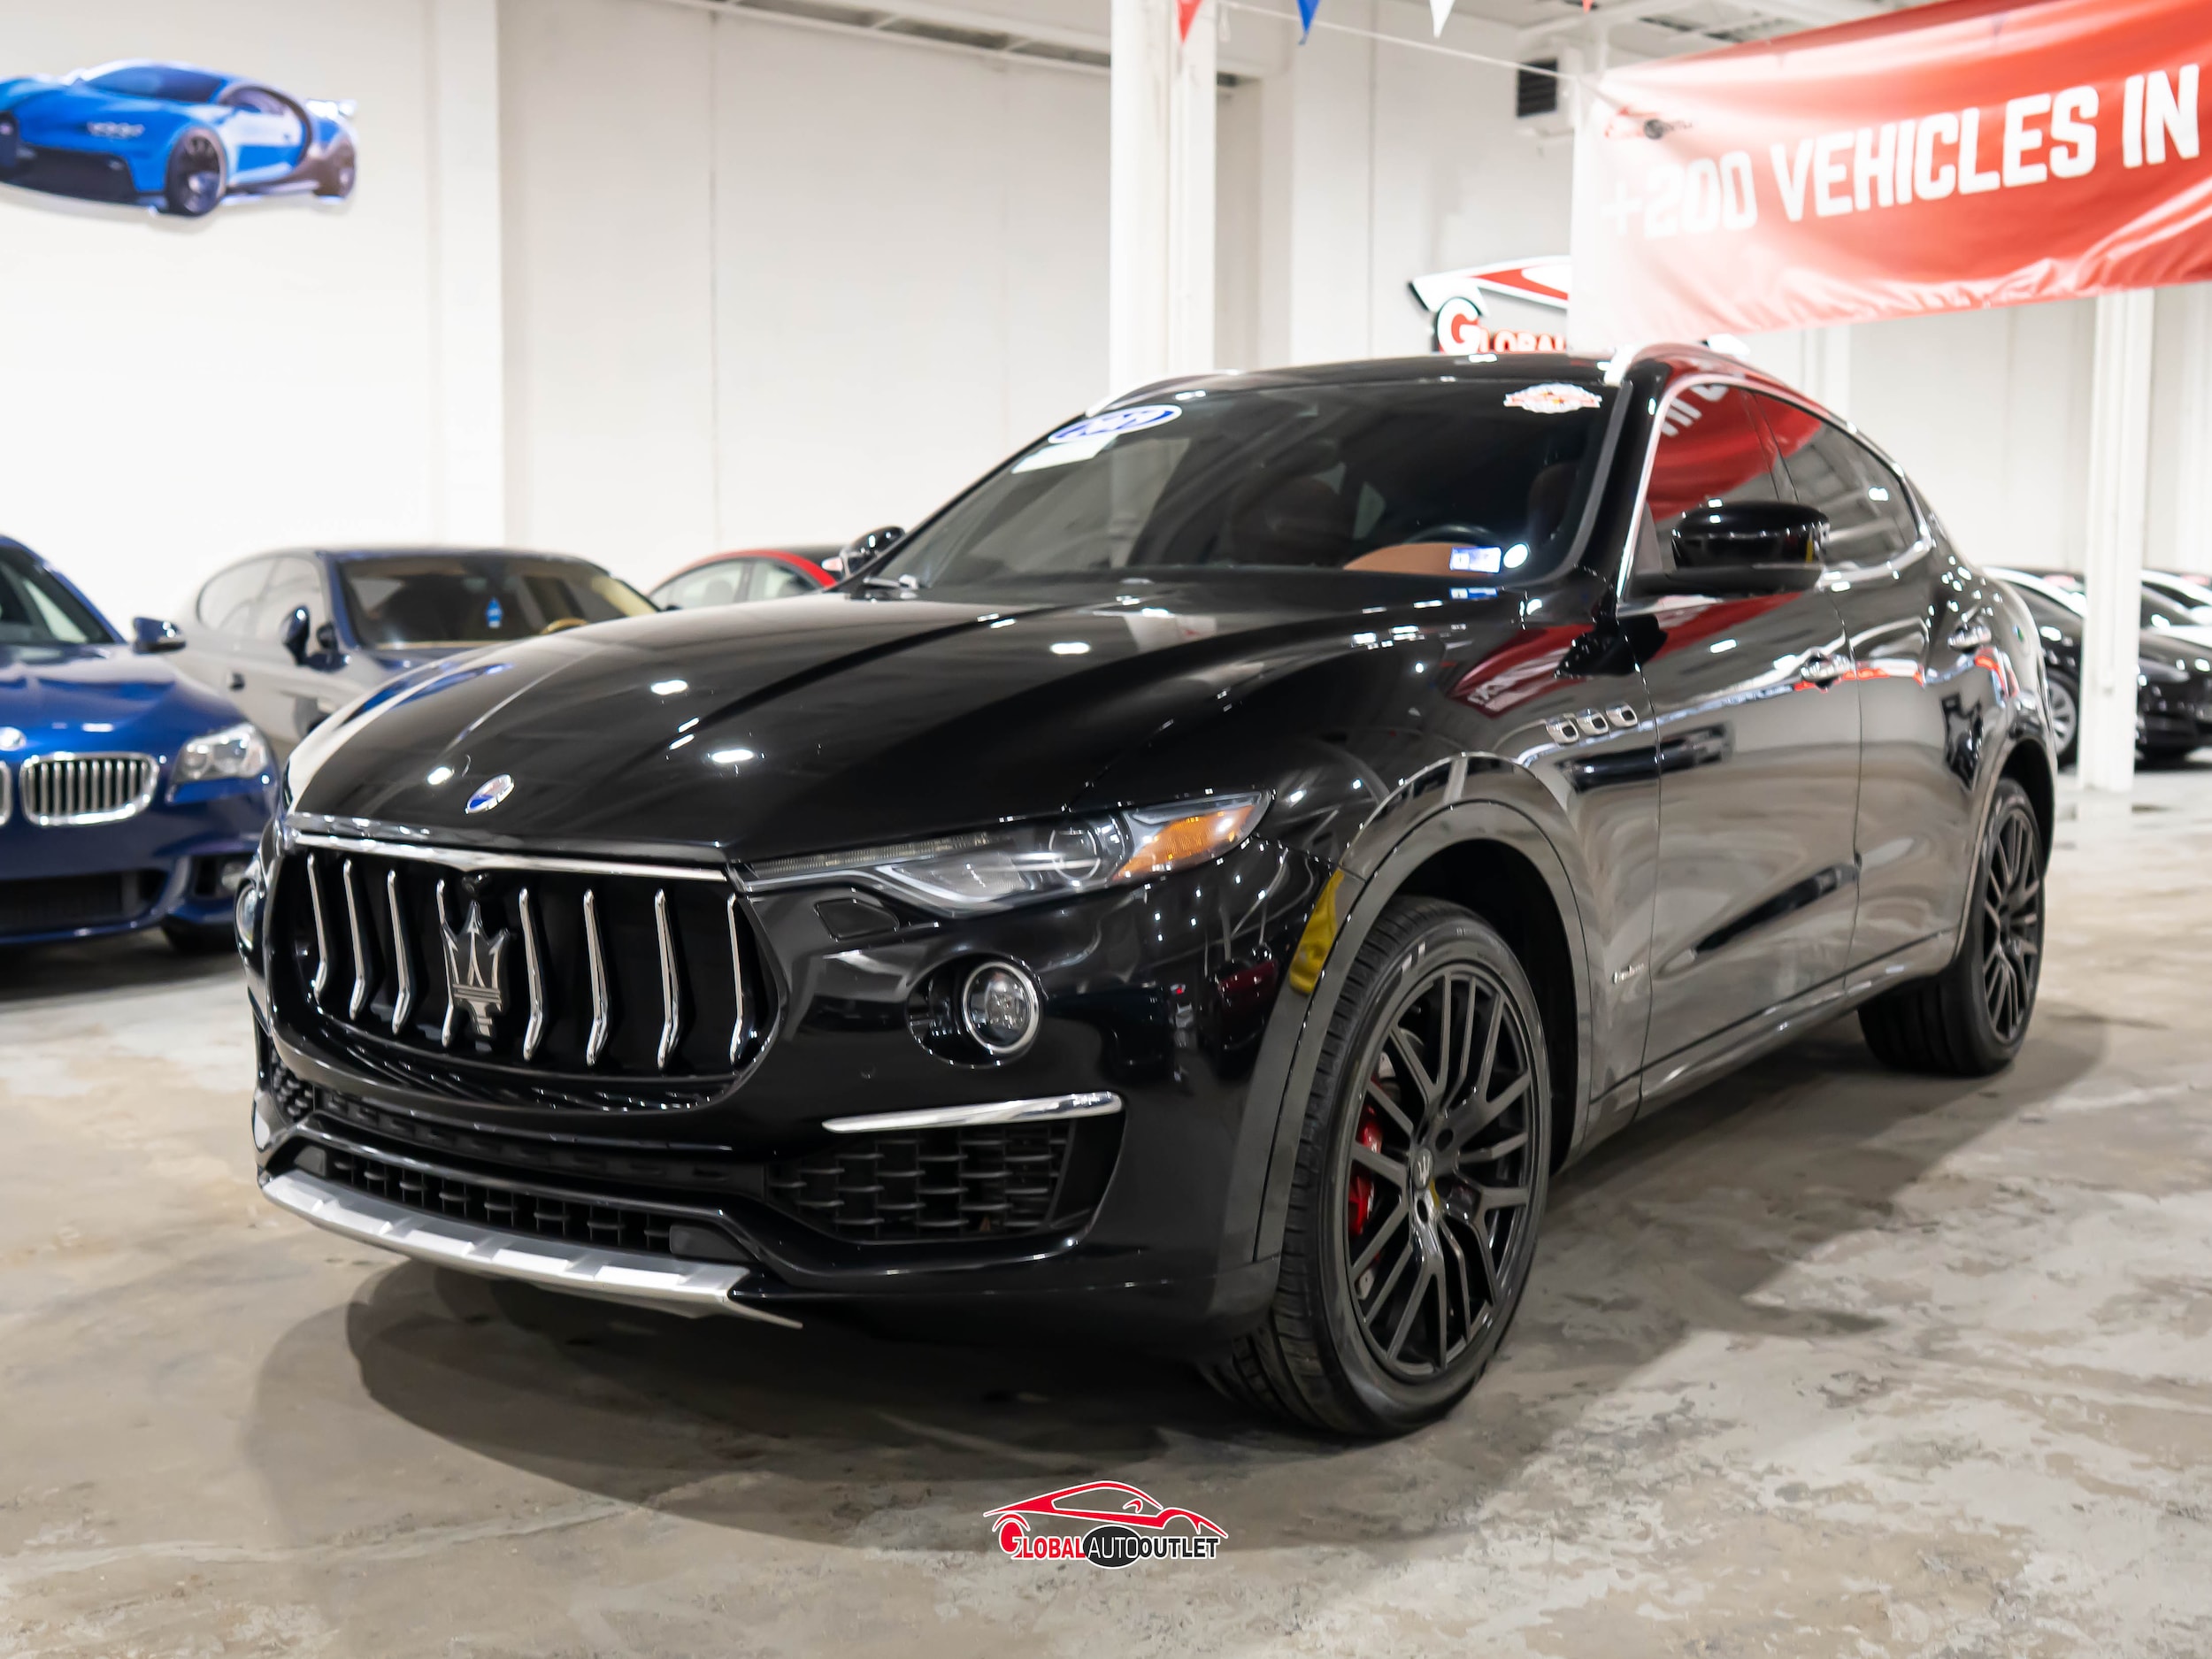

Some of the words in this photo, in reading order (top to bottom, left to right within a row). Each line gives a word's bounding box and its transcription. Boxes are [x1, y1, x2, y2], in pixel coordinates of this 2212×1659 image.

[1599, 151, 1758, 239] +200
[1770, 85, 2100, 222] VEHICLES
[2122, 64, 2200, 169] IN
